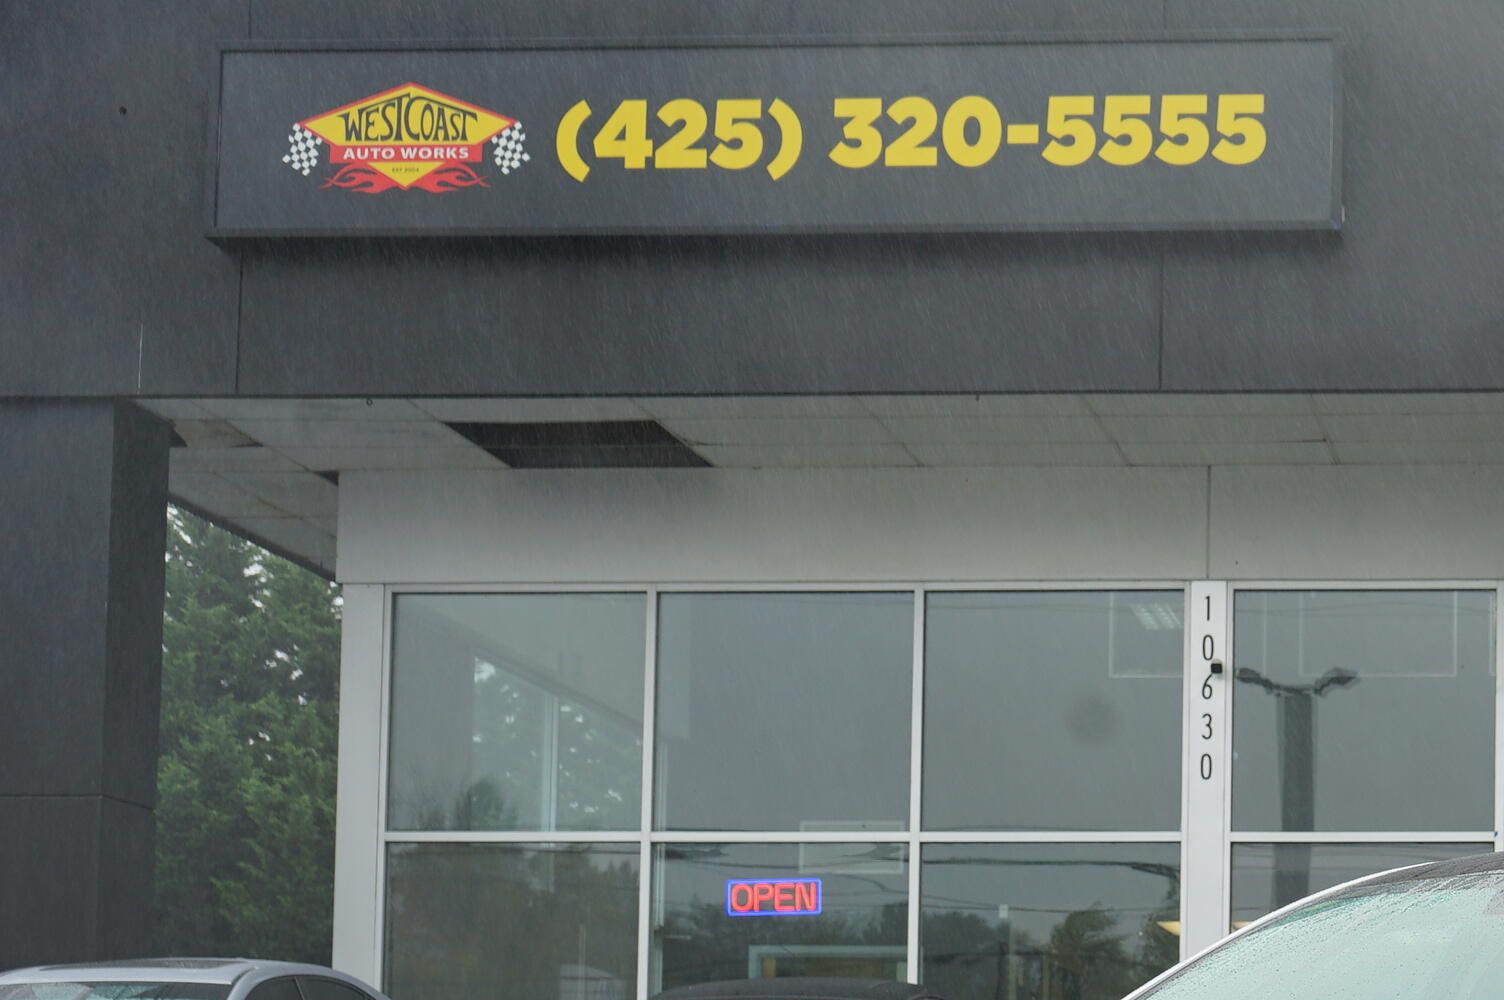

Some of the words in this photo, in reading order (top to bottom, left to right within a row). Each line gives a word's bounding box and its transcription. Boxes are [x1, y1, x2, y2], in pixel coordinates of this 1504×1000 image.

[556, 97, 803, 182] (425)
[828, 93, 1267, 168] 320-5555
[343, 147, 395, 160] AUTO
[400, 147, 469, 159] WORKS
[731, 882, 817, 912] OPEN
